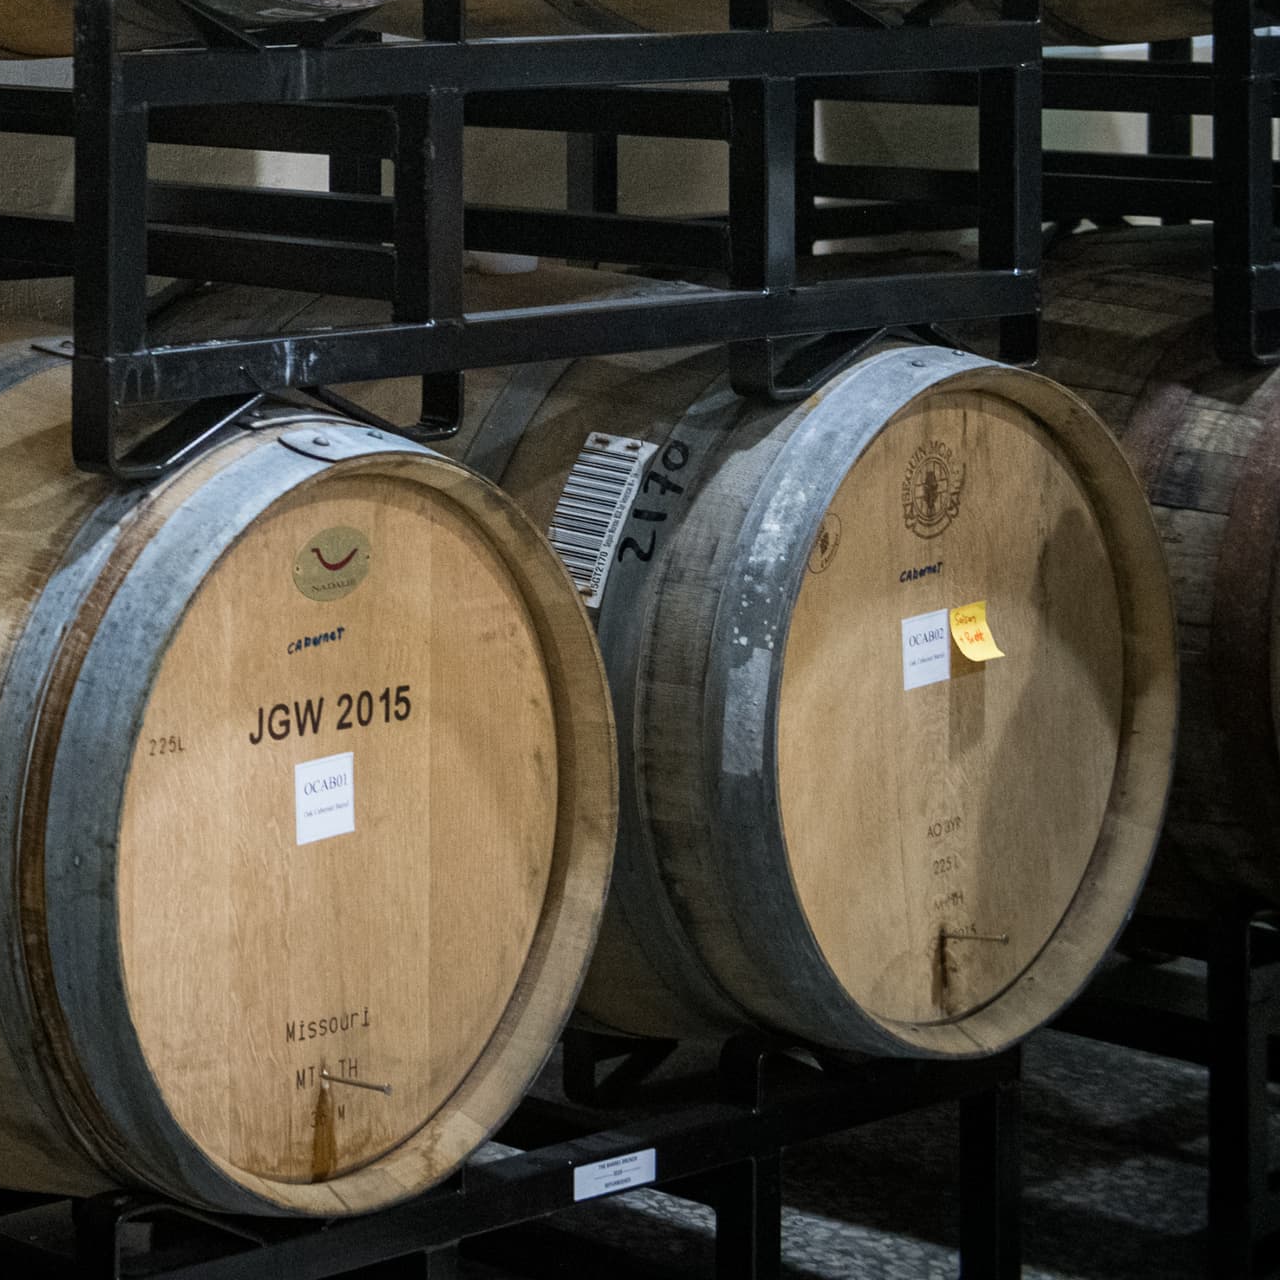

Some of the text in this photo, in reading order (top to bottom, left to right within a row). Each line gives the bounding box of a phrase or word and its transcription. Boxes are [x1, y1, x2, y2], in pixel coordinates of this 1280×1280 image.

[617, 440, 690, 563] 2170
[908, 627, 945, 647] OCAB02
[249, 685, 412, 745] JGW 2015
[148, 735, 186, 757] 225L
[304, 773, 348, 796] OCAB01
[286, 1006, 370, 1042] Missouri
[296, 1058, 358, 1090] MT TH
